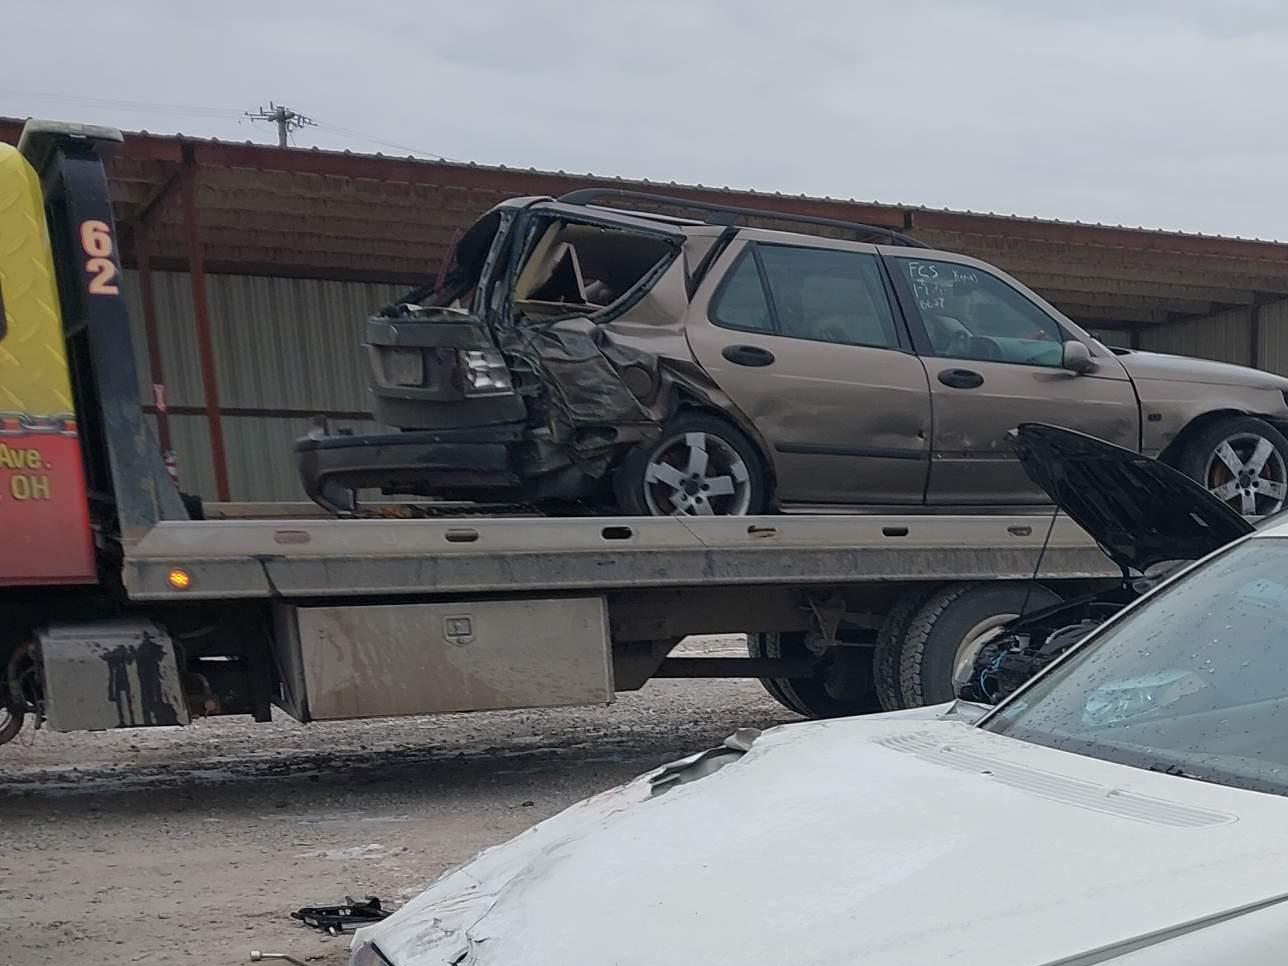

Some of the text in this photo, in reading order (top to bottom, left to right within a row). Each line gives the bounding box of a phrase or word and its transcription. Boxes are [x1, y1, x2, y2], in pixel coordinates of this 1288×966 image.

[80, 219, 119, 295] 62
[908, 261, 938, 279] FCS
[11, 473, 51, 500] OH
